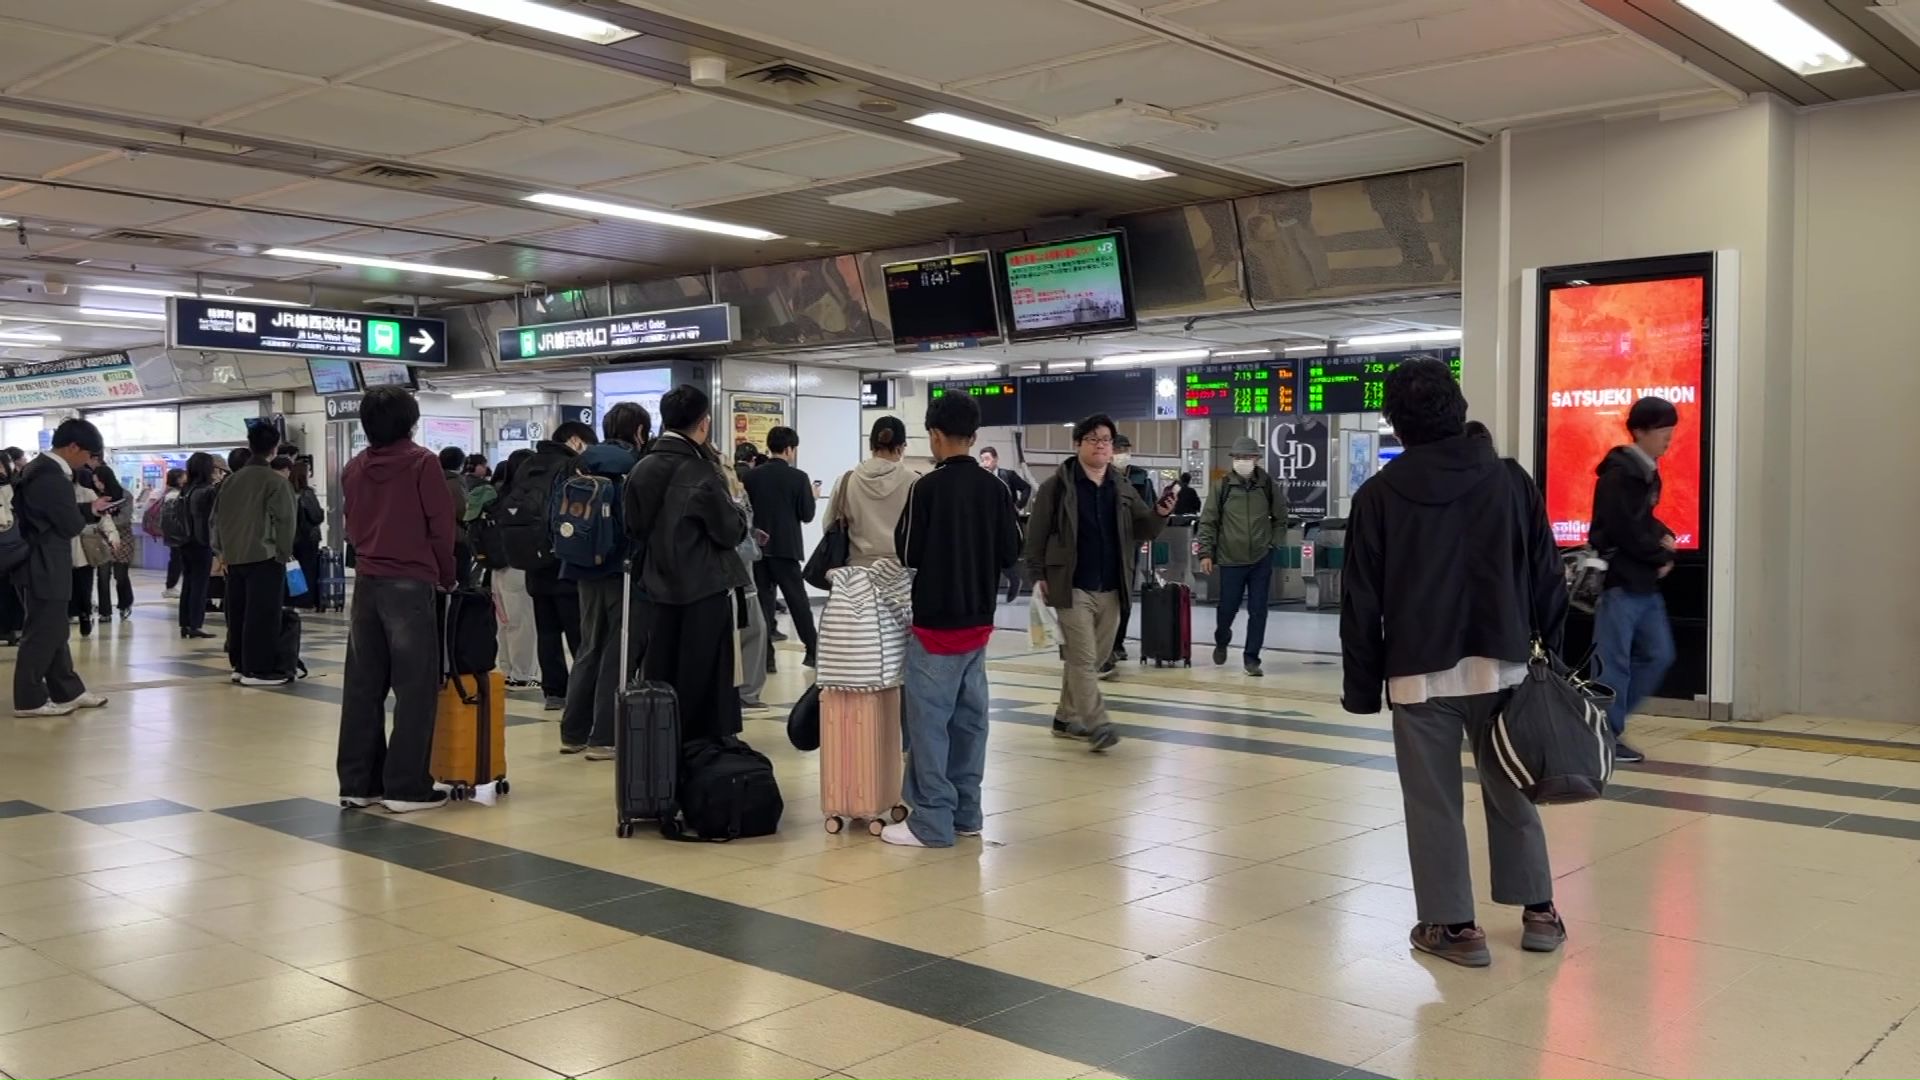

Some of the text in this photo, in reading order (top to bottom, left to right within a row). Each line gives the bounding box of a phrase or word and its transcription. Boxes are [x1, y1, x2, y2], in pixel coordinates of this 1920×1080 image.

[271, 312, 361, 333] JR線西改札口
[537, 328, 607, 351] JR線西改札口
[1552, 386, 1695, 408] SATSUEKI VISION
